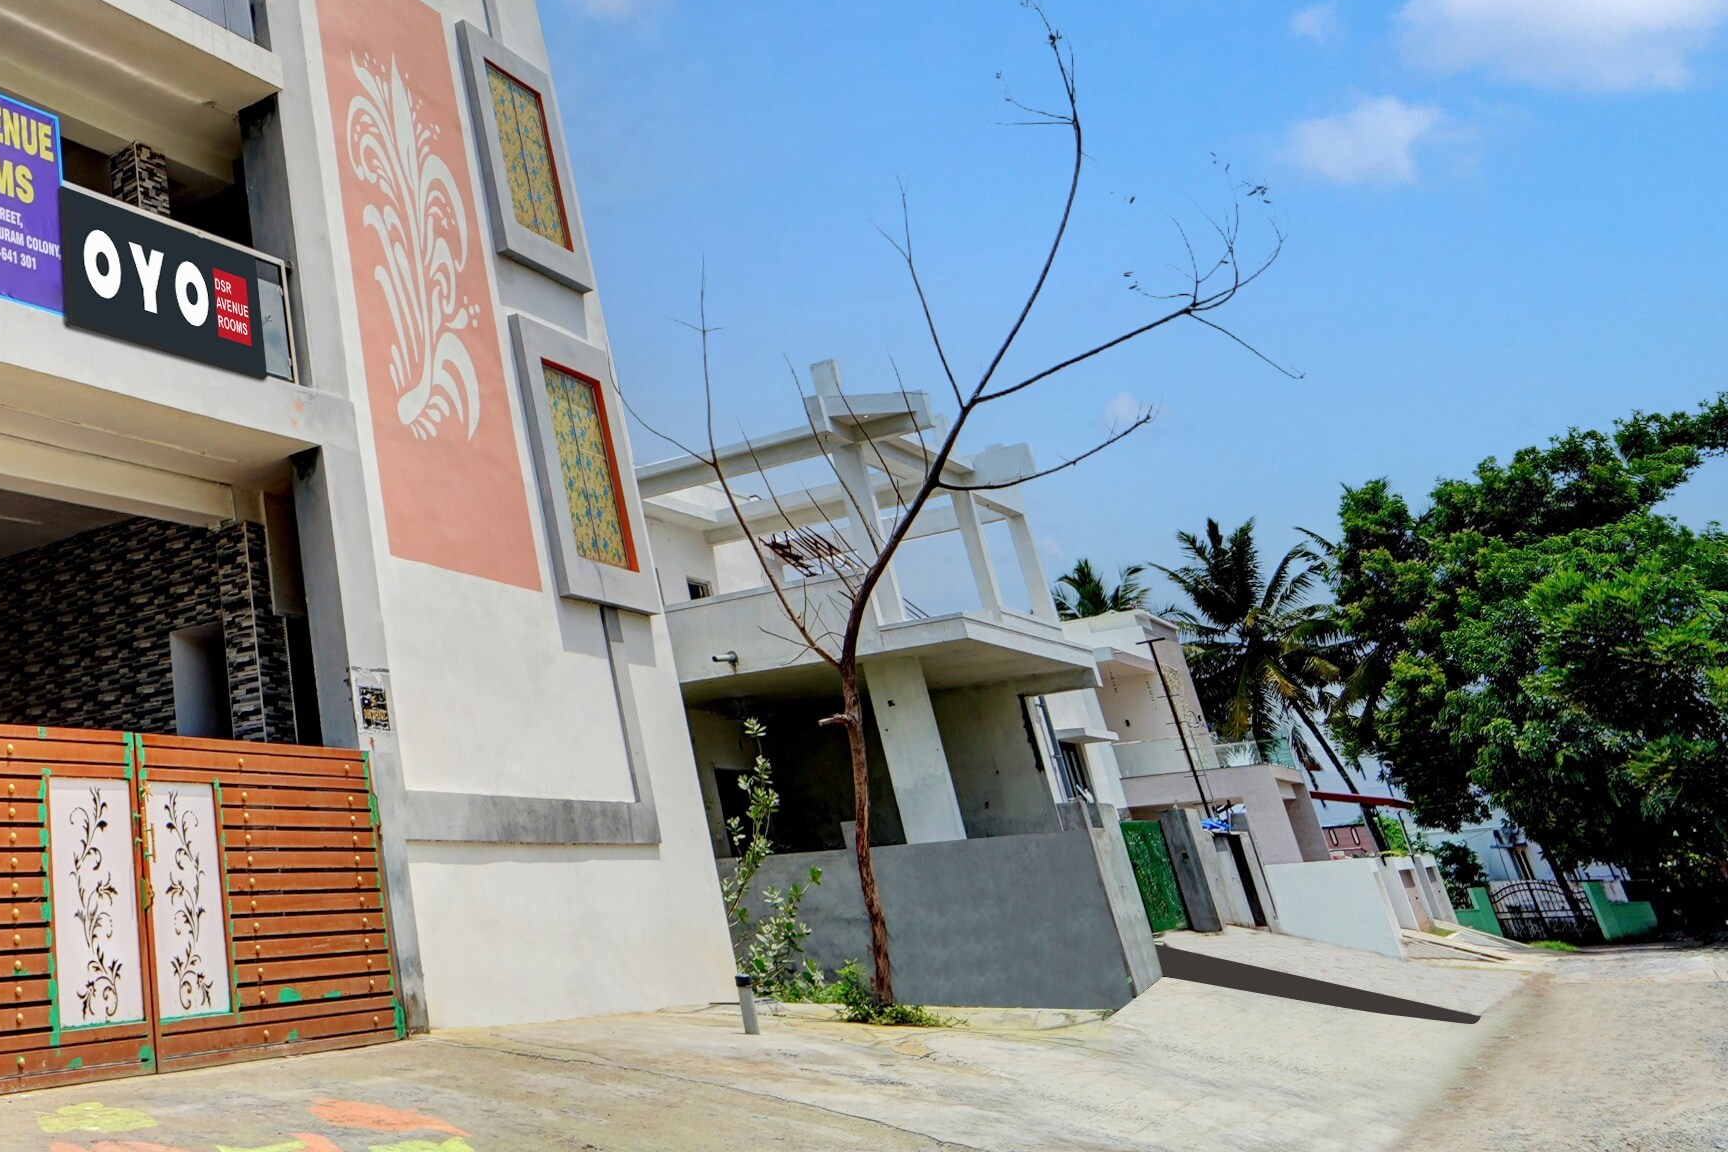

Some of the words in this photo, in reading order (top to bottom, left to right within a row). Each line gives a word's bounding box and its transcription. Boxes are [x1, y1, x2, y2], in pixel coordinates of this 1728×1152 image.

[26, 235, 62, 261] COLONY,
[20, 252, 37, 271] 301
[83, 229, 210, 327] OYO
[214, 277, 233, 295] DSR
[216, 296, 250, 319] AVENUE
[217, 314, 249, 336] ROOMS
